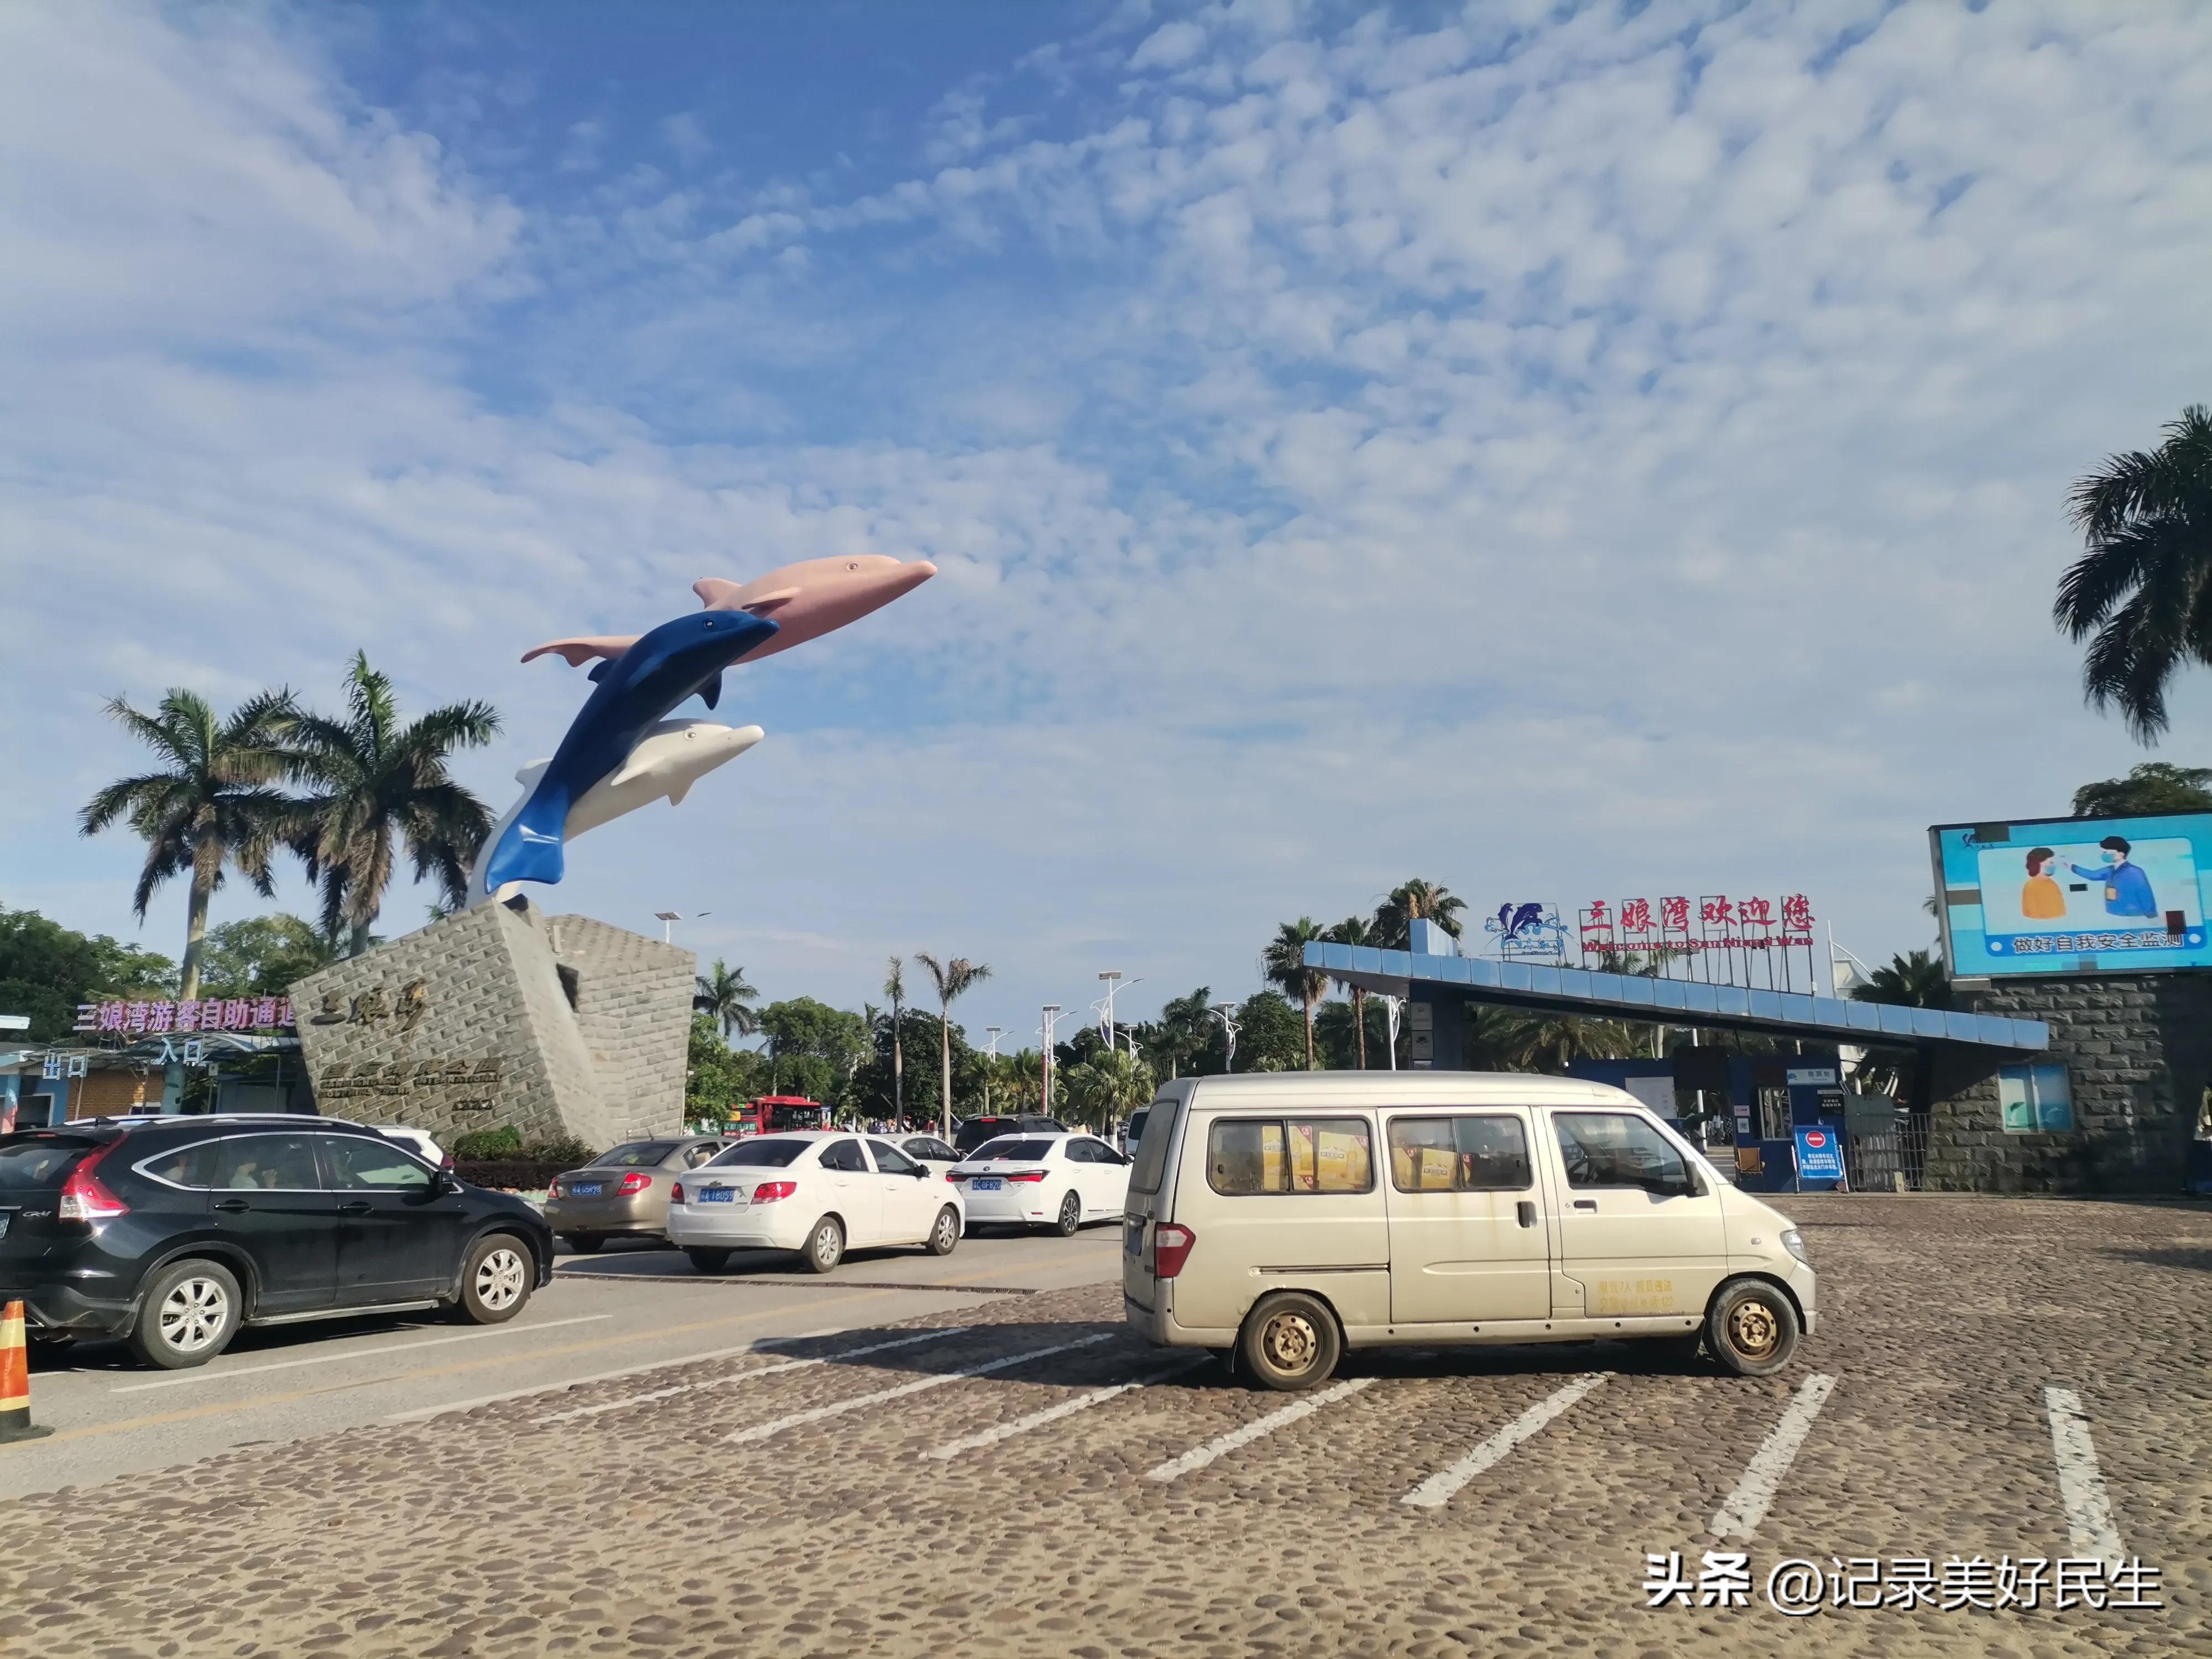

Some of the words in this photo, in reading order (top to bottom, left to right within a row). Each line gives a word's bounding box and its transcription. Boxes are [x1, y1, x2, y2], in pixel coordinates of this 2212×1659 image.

[1579, 894, 1816, 933] 三娘湾欢迎您
[1582, 940, 1662, 952] Welcome
[1666, 940, 1683, 949] to
[1688, 938, 1720, 948] San
[1723, 936, 1772, 950] Niang
[1776, 935, 1813, 946] Wan
[2013, 931, 2184, 953] 做好自我安全监测
[310, 978, 427, 1032] 三娘湾
[148, 1035, 202, 1066] 入口
[43, 1051, 87, 1080] 出口
[320, 1058, 500, 1078] 国际海豚公园
[414, 1073, 504, 1088] INTERNATIONAL
